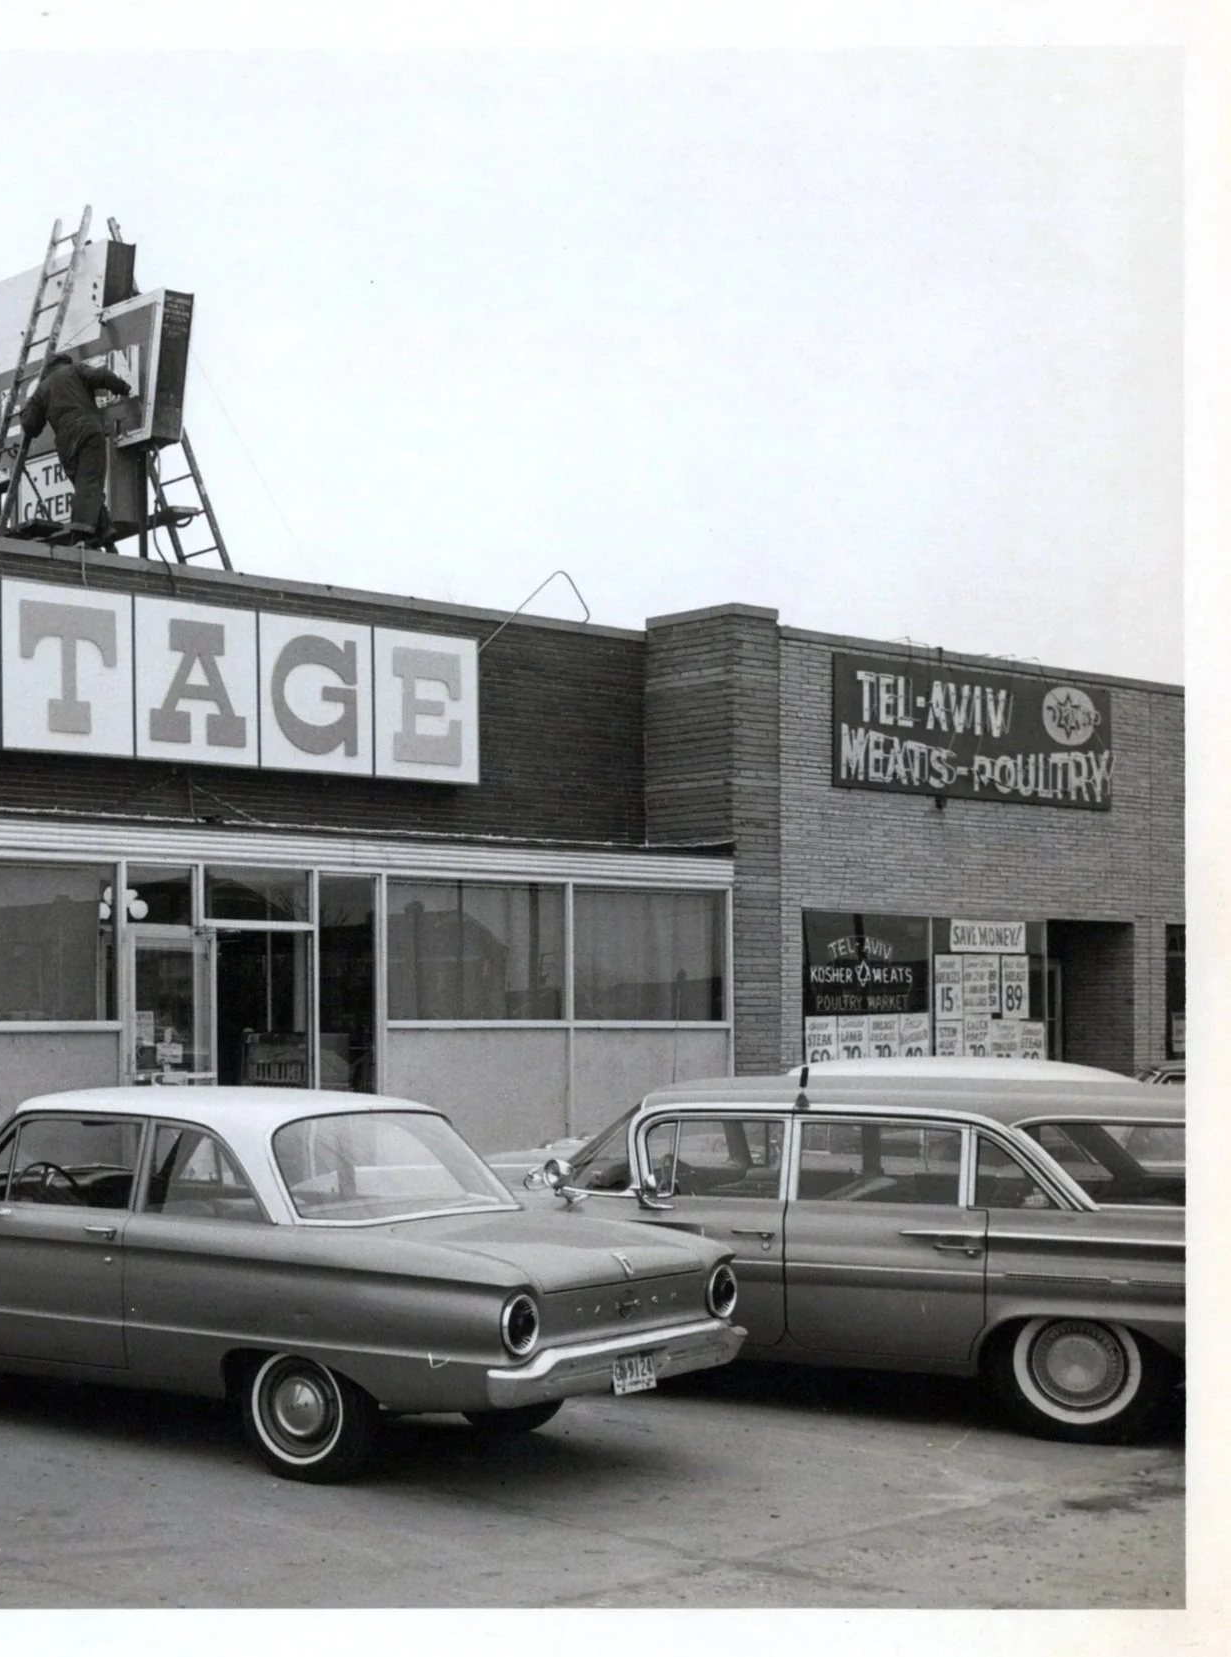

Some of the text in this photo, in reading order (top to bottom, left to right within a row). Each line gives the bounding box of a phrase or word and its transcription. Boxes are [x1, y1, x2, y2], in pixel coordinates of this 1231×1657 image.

[856, 670, 1013, 738] TEL-AVIV
[953, 925, 978, 945] SAVE
[827, 937, 893, 960] TEL-AVIV
[810, 966, 914, 984] KOSHER MEATS
[816, 994, 910, 1011] POULTRY MARKET
[941, 986, 954, 1012] 15
[1006, 984, 1023, 1012] 89
